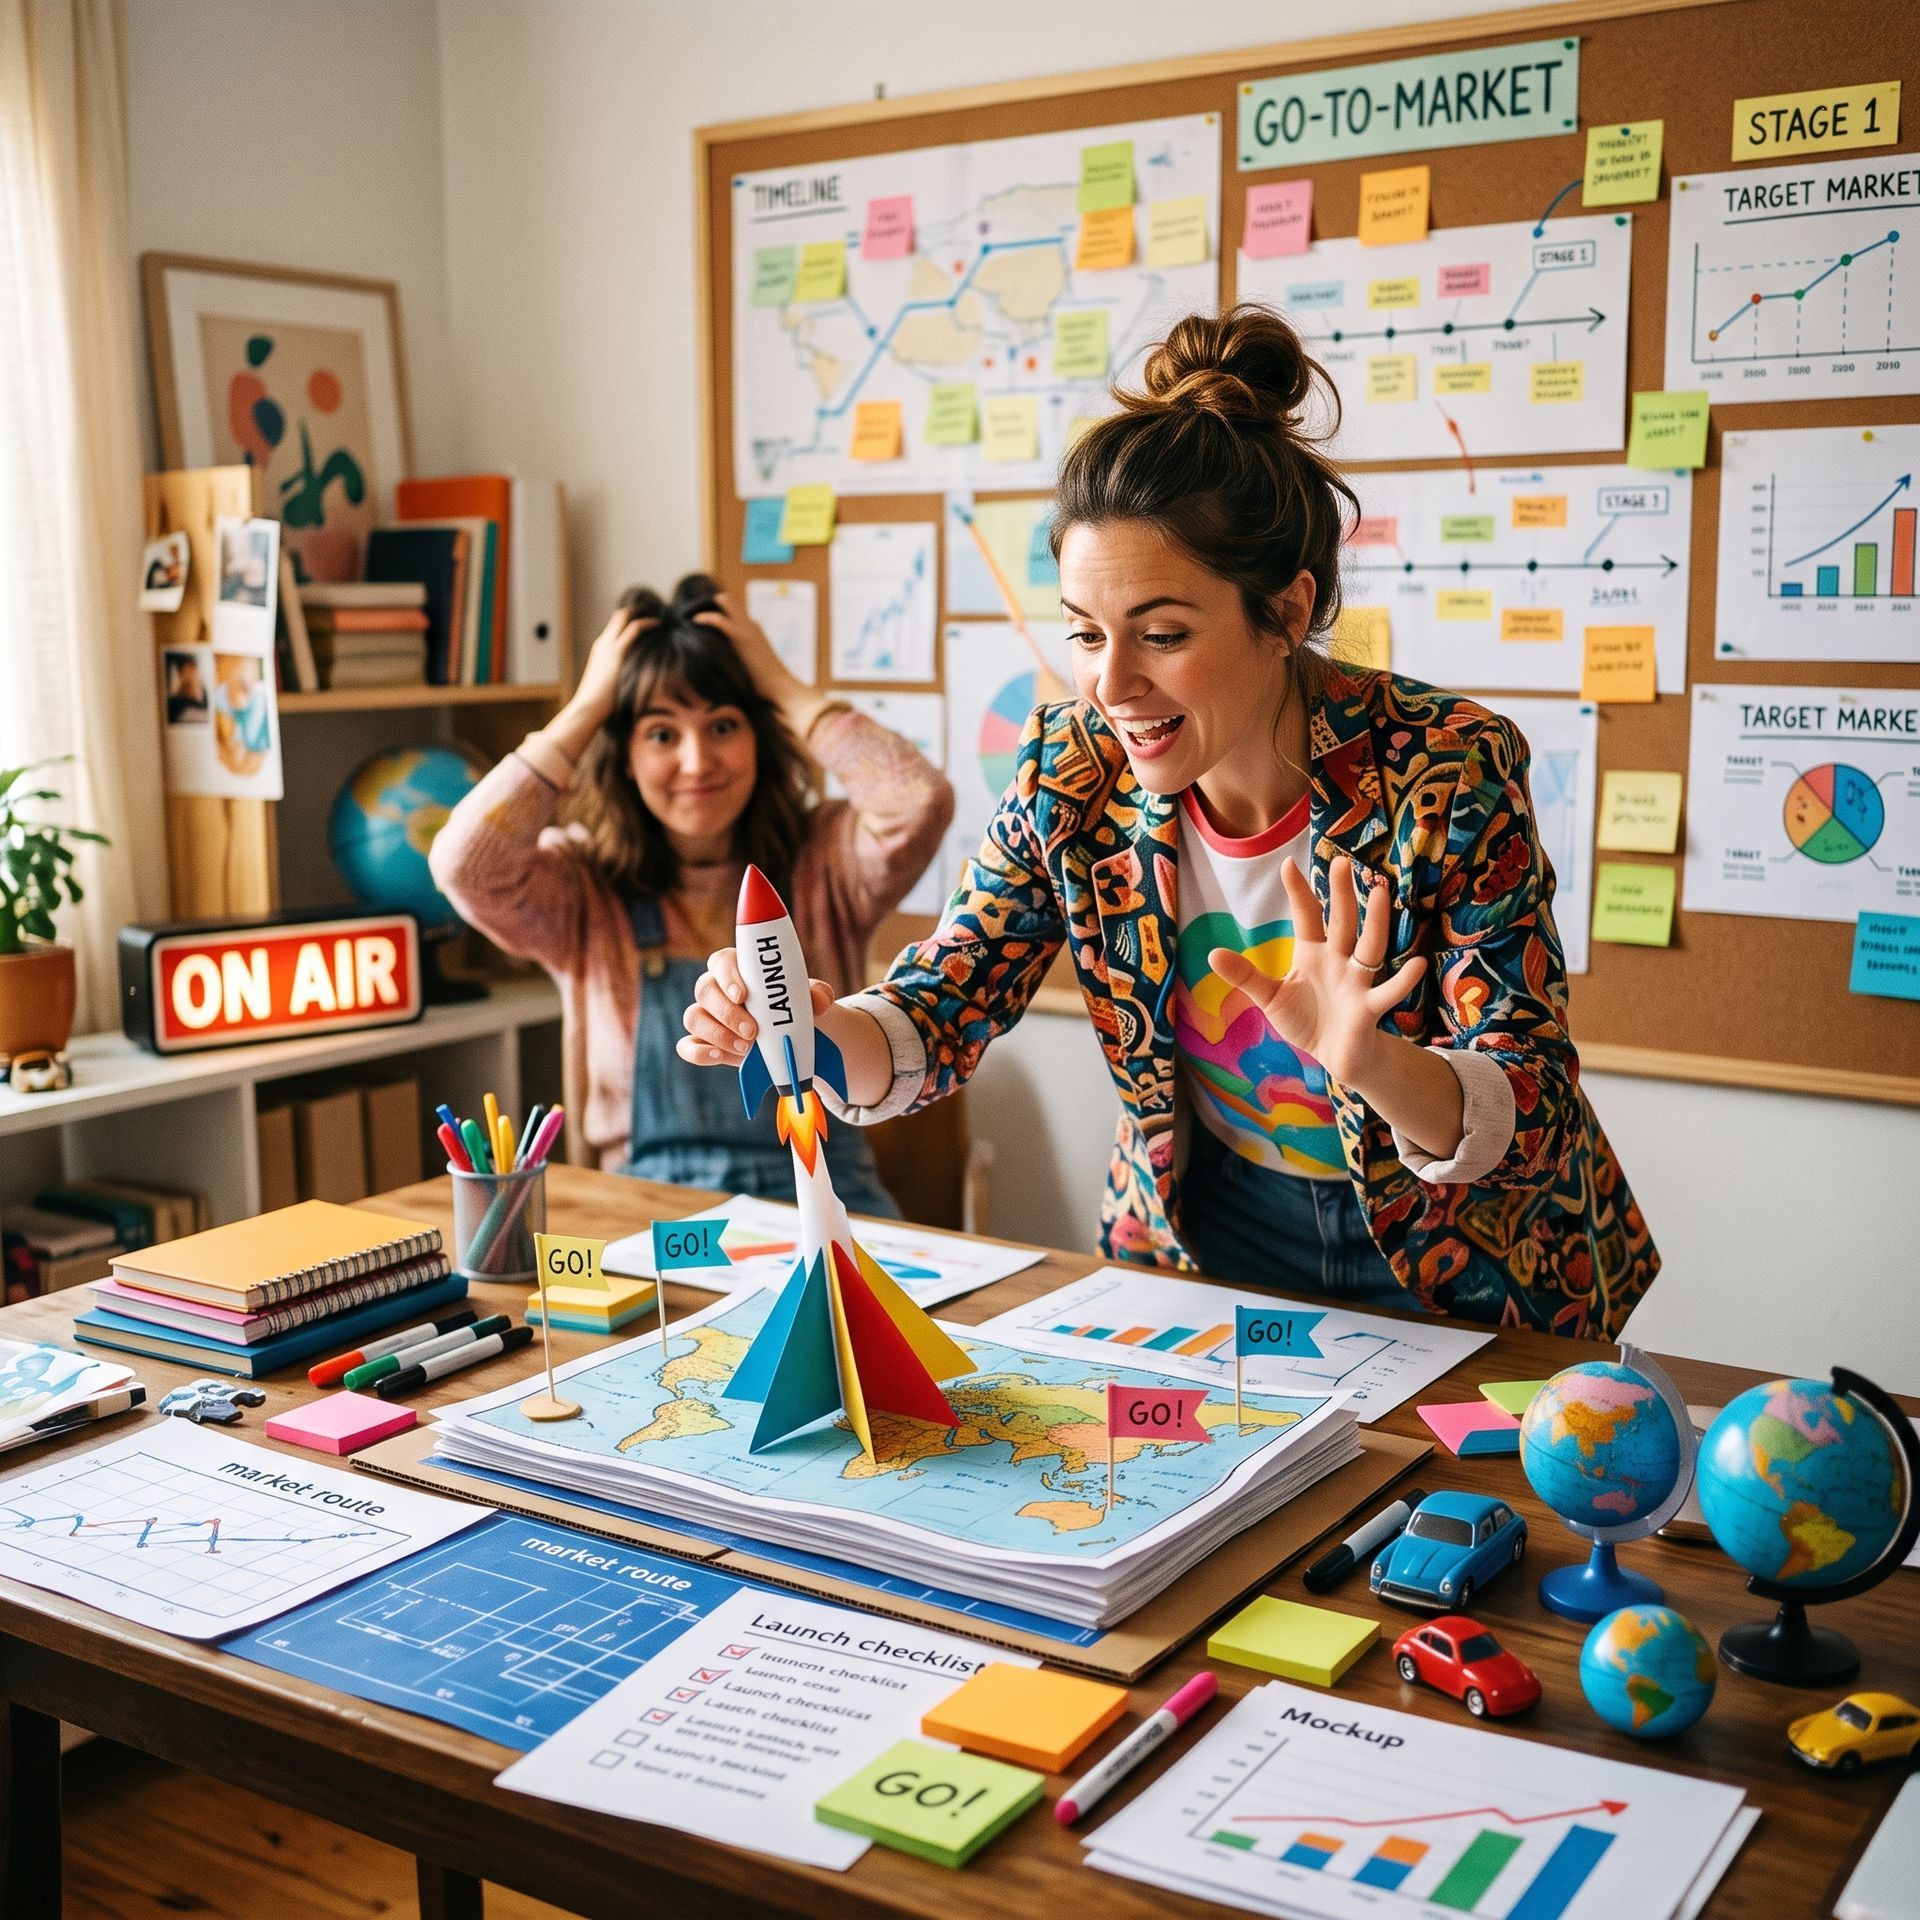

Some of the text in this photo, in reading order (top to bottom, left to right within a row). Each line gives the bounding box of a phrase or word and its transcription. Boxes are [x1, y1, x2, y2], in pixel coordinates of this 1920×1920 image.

[1255, 60, 1563, 147] GO-TO-MARKET
[1749, 97, 1881, 145] STAGE 1
[752, 174, 843, 212] TIMELINE
[1724, 180, 1815, 212] TARGET
[1740, 704, 1827, 730] TARGET
[172, 936, 400, 1029] ON AIR
[756, 935, 794, 1026] LAUNCH
[549, 1248, 592, 1278] GO!
[665, 1227, 708, 1258] GO!
[1247, 1319, 1293, 1346] GO!
[1128, 1399, 1182, 1428] GO!
[218, 1462, 385, 1517] market route
[520, 1537, 692, 1591] market route
[751, 1613, 987, 1675] Launch checklist
[723, 1681, 782, 1701] Launch
[1279, 1707, 1405, 1750] Mockup
[873, 1770, 991, 1817] GO!
